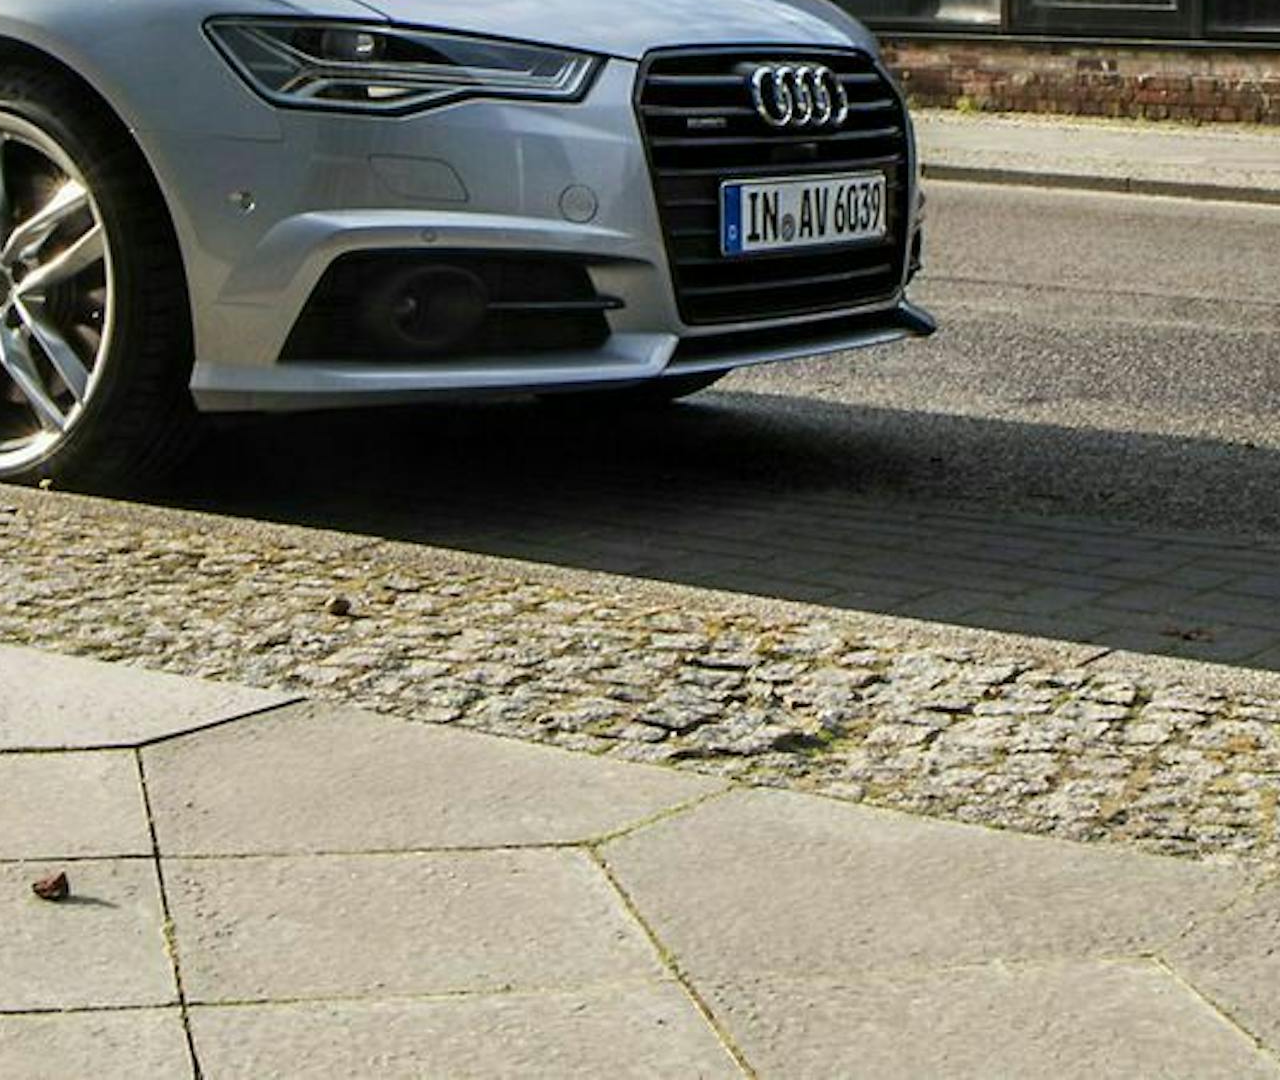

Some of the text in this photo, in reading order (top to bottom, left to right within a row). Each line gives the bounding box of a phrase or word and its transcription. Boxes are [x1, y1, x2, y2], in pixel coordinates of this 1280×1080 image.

[746, 182, 881, 242] IN AV 6039
